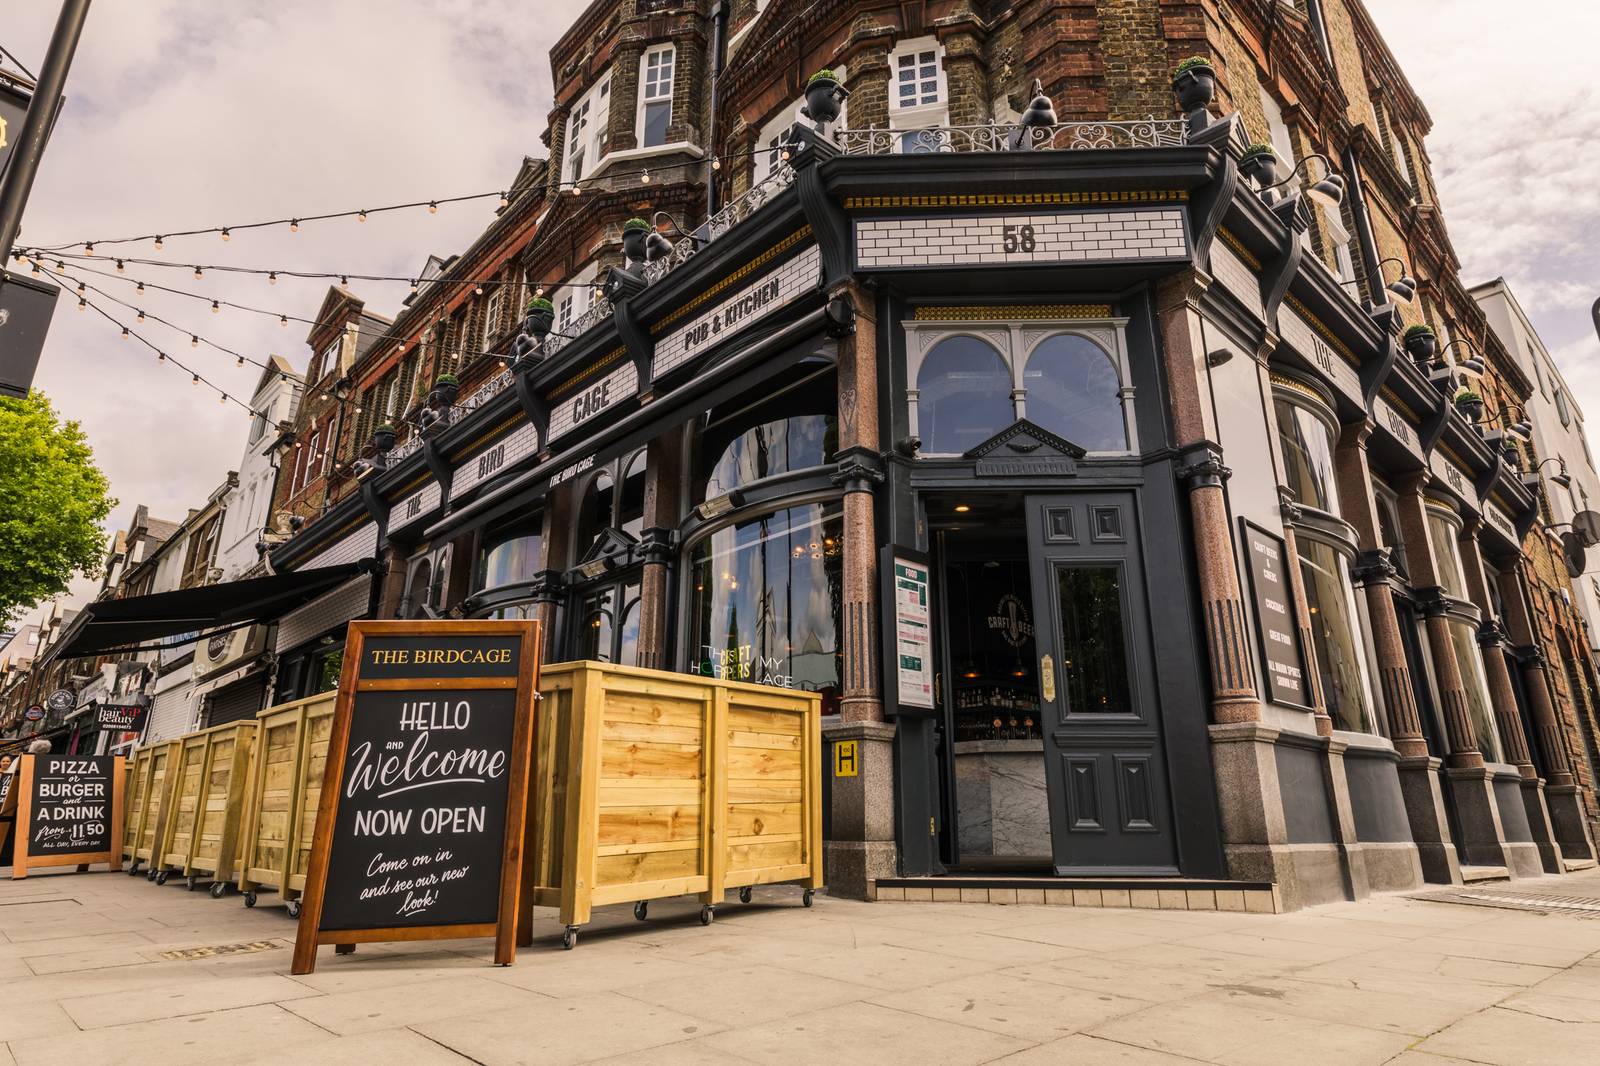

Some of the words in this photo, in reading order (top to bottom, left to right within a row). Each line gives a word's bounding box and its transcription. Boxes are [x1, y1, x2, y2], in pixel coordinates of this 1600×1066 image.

[1003, 225, 1036, 253] 58
[684, 322, 709, 350] PUB
[712, 315, 721, 334] &
[724, 278, 779, 328] KITCHEN
[572, 378, 612, 424] CAGE
[478, 444, 504, 480] BIRD
[550, 472, 562, 488] THE
[562, 464, 578, 482] BIRD
[576, 454, 597, 474] CAGE
[406, 492, 423, 520] THE
[905, 568, 918, 579] FOOD
[987, 616, 1010, 629] CRAFT
[372, 650, 408, 664] THE
[414, 649, 512, 664] BIRDCAGE
[760, 656, 783, 670] MY
[755, 674, 793, 688] LACE
[98, 714, 135, 726] beauty
[99, 706, 122, 718] hair
[400, 700, 470, 731] HELLO
[386, 741, 404, 750] AND
[50, 760, 100, 774] PIZZA
[346, 731, 505, 798] Welcome
[838, 744, 854, 772] H
[40, 784, 104, 796] BURGER
[62, 796, 82, 804] and
[36, 808, 50, 820] A
[54, 806, 104, 820] DRINK
[354, 808, 412, 836] NOW
[420, 806, 486, 834] OPEN
[35, 824, 66, 842] from
[366, 853, 408, 877] Come
[412, 854, 432, 866] on
[436, 848, 452, 862] in
[360, 876, 390, 900] and
[391, 880, 414, 894] see
[416, 872, 438, 888] our
[442, 866, 470, 882] new
[396, 890, 438, 914] look!
